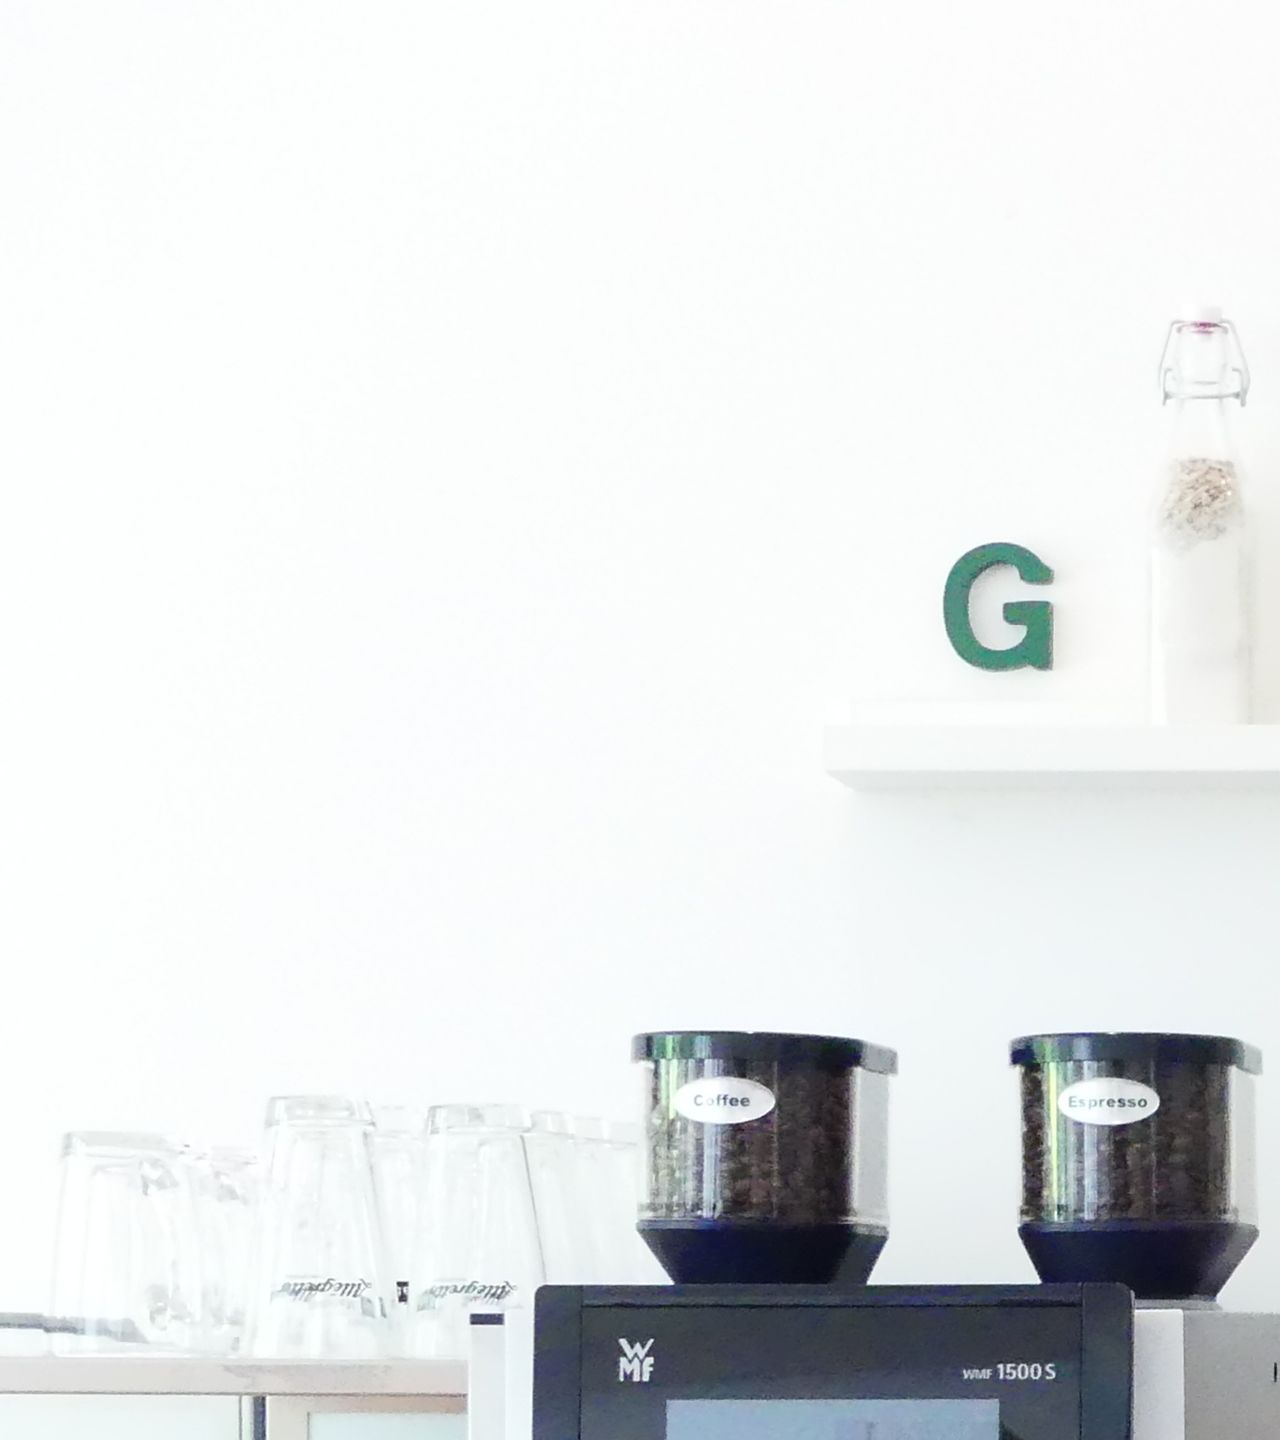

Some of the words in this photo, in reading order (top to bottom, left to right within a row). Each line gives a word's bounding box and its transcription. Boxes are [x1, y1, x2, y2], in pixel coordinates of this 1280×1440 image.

[692, 1093, 752, 1109] Coffee
[1067, 1094, 1149, 1111] Espresso
[962, 1369, 993, 1381] WMF
[996, 1363, 1042, 1380] 1500
